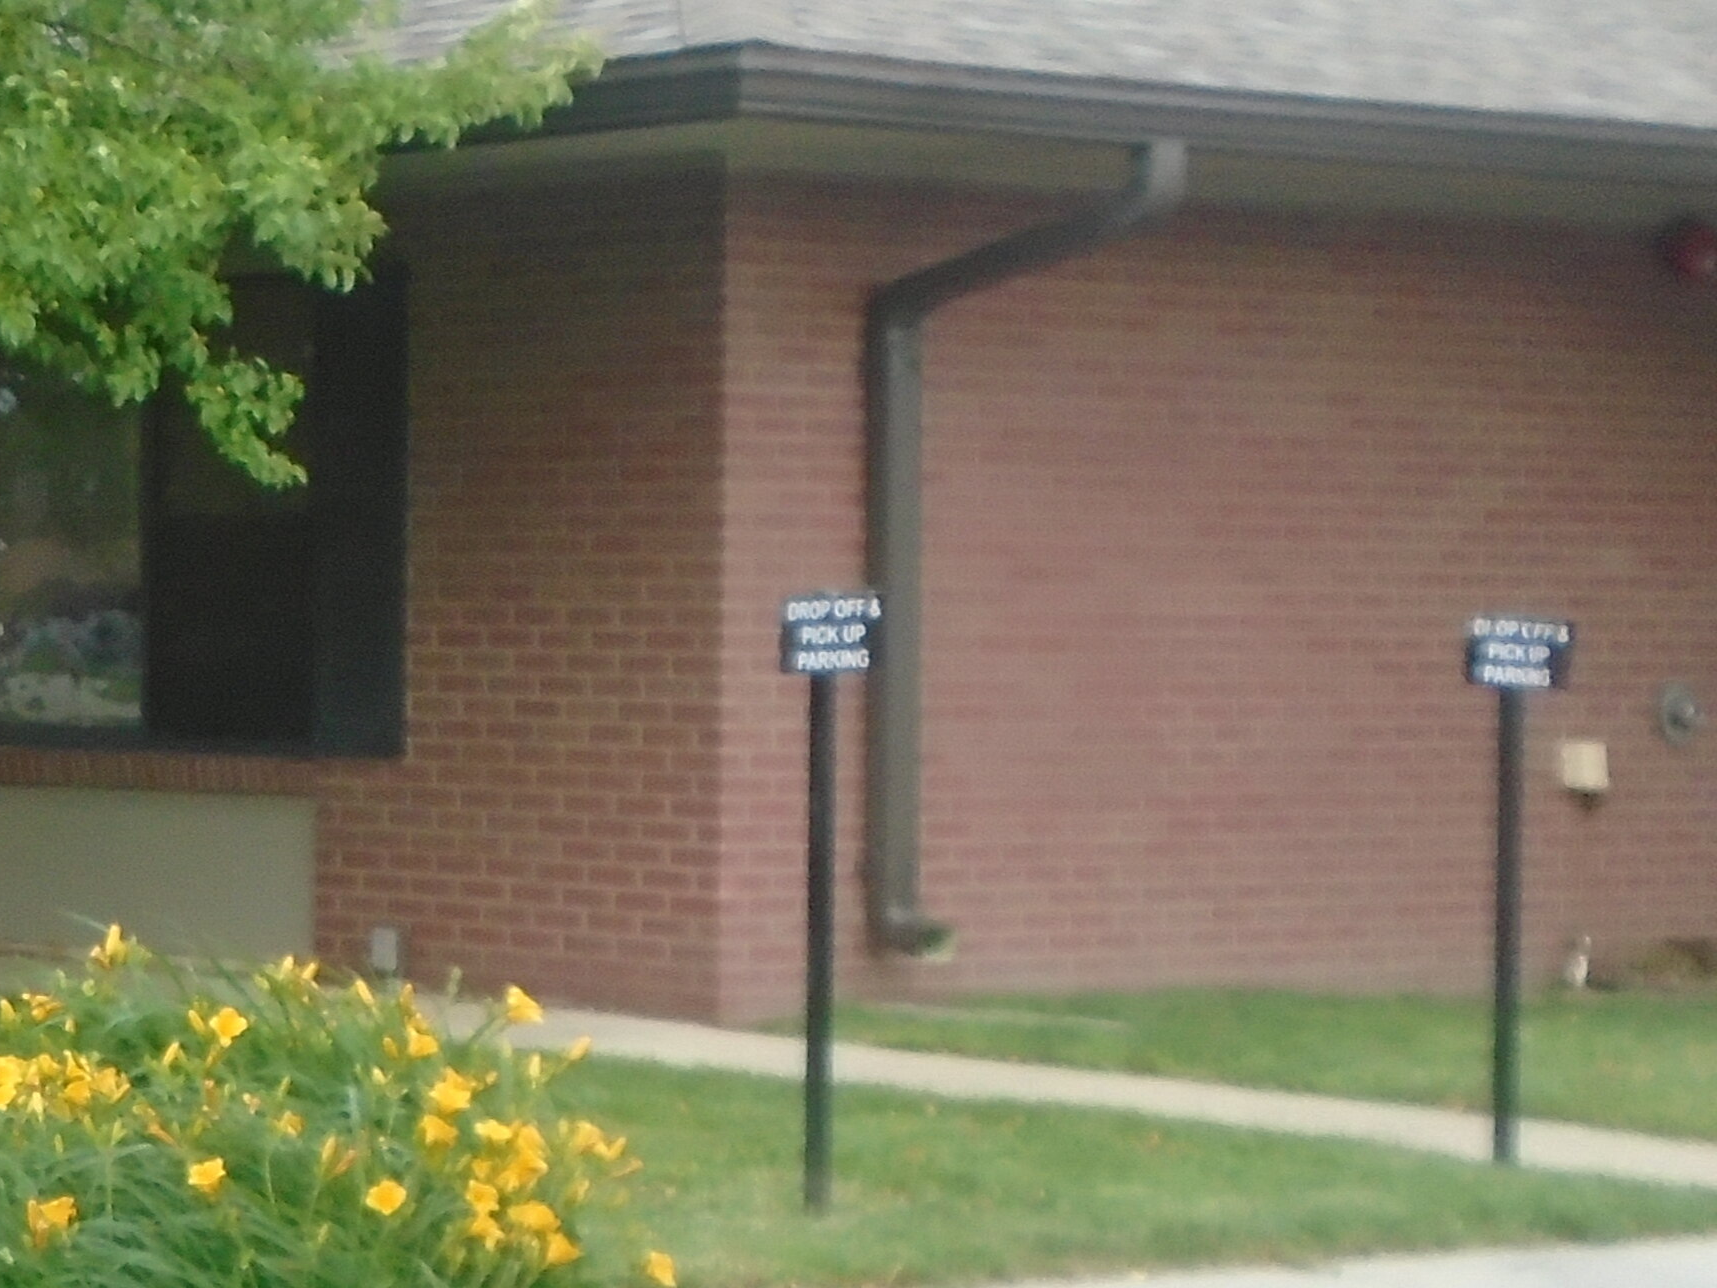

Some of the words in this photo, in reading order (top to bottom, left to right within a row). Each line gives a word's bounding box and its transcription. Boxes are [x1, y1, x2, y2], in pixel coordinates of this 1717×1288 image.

[787, 601, 831, 621] DROP
[834, 599, 865, 618] OFF
[869, 598, 882, 619] &
[801, 626, 839, 645] PICK
[843, 623, 867, 643] UP
[797, 649, 870, 670] PARKING
